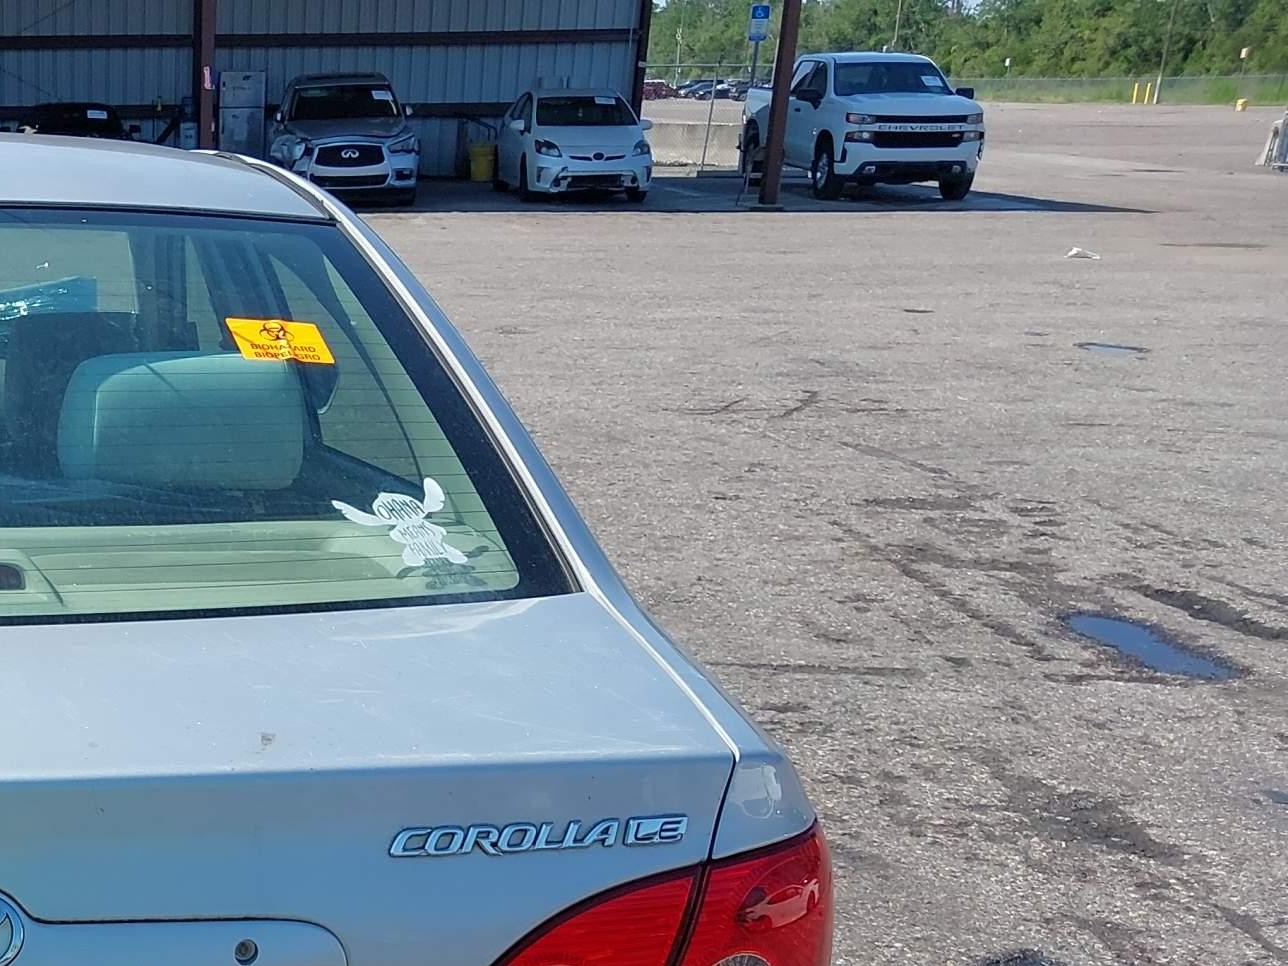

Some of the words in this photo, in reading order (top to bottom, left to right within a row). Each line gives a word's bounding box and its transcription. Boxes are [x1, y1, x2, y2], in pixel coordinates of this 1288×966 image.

[377, 498, 426, 521] OHANA
[397, 522, 436, 541] MEANS
[389, 817, 621, 857] COROLLA
[623, 813, 688, 846] LE
